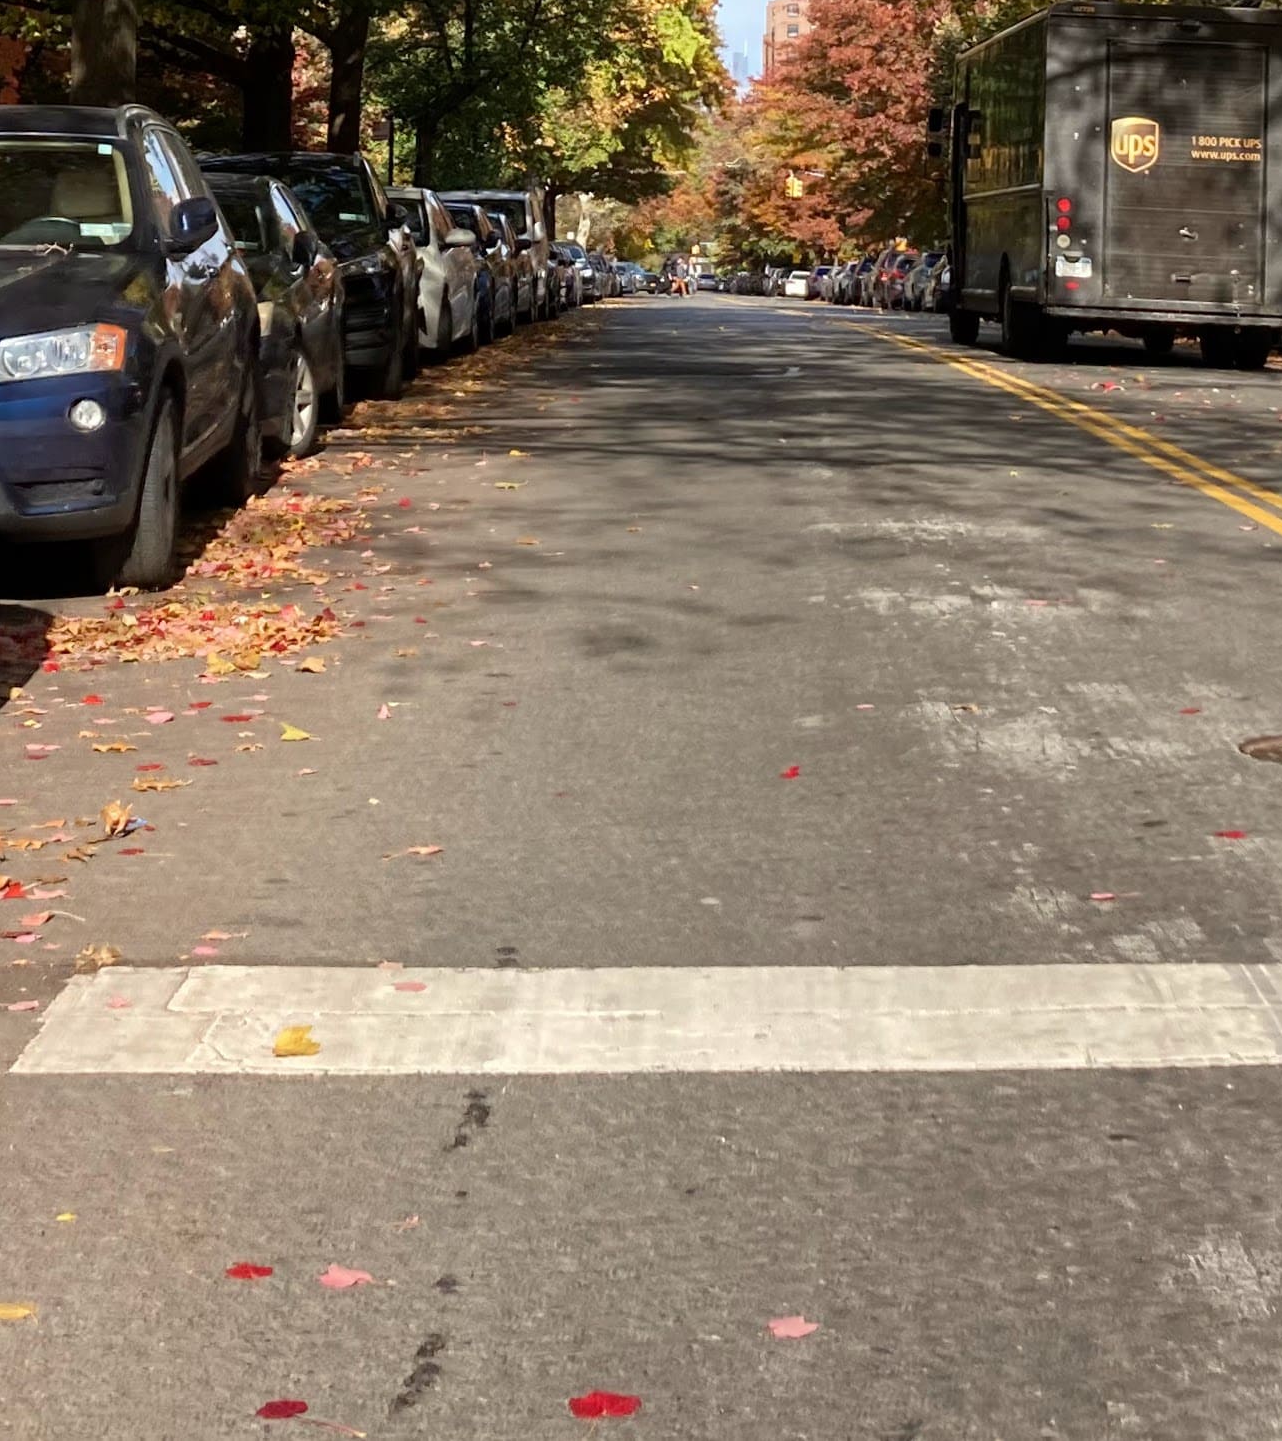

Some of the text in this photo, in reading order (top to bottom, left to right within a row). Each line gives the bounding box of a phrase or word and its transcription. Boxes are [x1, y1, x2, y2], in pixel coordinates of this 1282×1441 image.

[1115, 134, 1156, 164] ups
[1198, 136, 1217, 147] 800
[1219, 137, 1241, 148] PICK
[1243, 139, 1263, 150] UPS
[1190, 149, 1262, 162] www.ups.com
